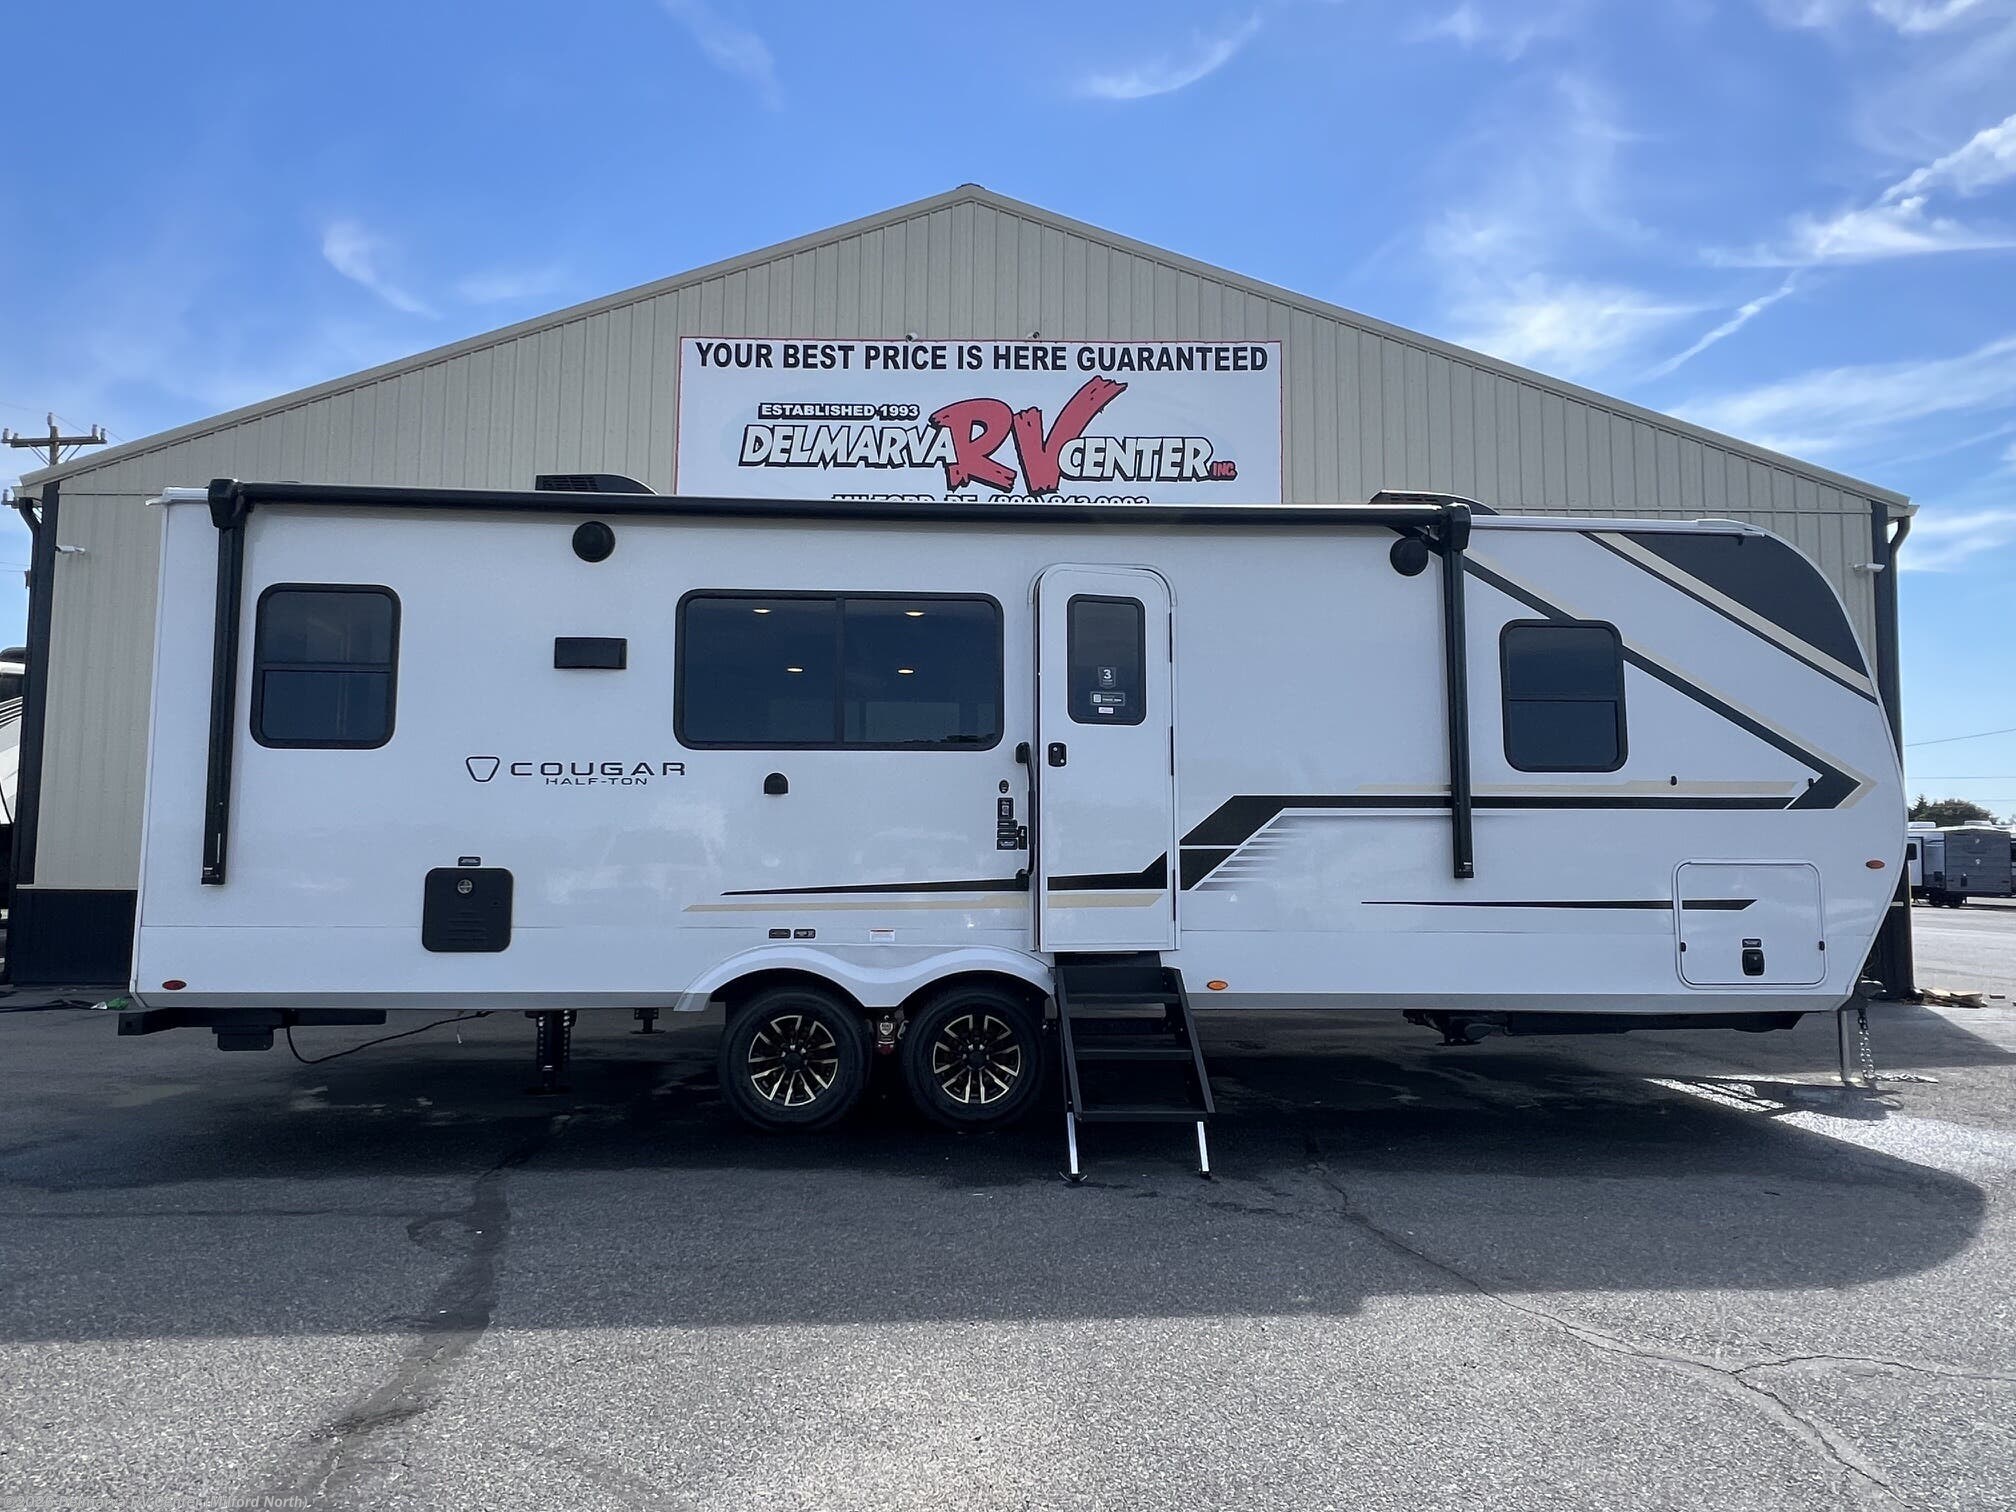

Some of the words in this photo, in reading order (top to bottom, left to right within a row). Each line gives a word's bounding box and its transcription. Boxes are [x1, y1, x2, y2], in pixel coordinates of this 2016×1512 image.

[695, 342, 773, 369] YOUR
[783, 344, 855, 370] BEST
[864, 345, 947, 371] PRICE
[957, 345, 983, 371] IS
[993, 346, 1067, 371] HERE
[1077, 346, 1268, 372] GUARANTEED
[760, 403, 876, 418] ESTABLISHED
[879, 404, 919, 419] 1993
[741, 424, 958, 467] DELMARVA
[928, 375, 1128, 496] RV
[1058, 437, 1213, 480] CENTER
[1103, 669, 1112, 679] 3
[510, 762, 687, 776] COUGAR
[545, 777, 648, 786] HALF-TON
